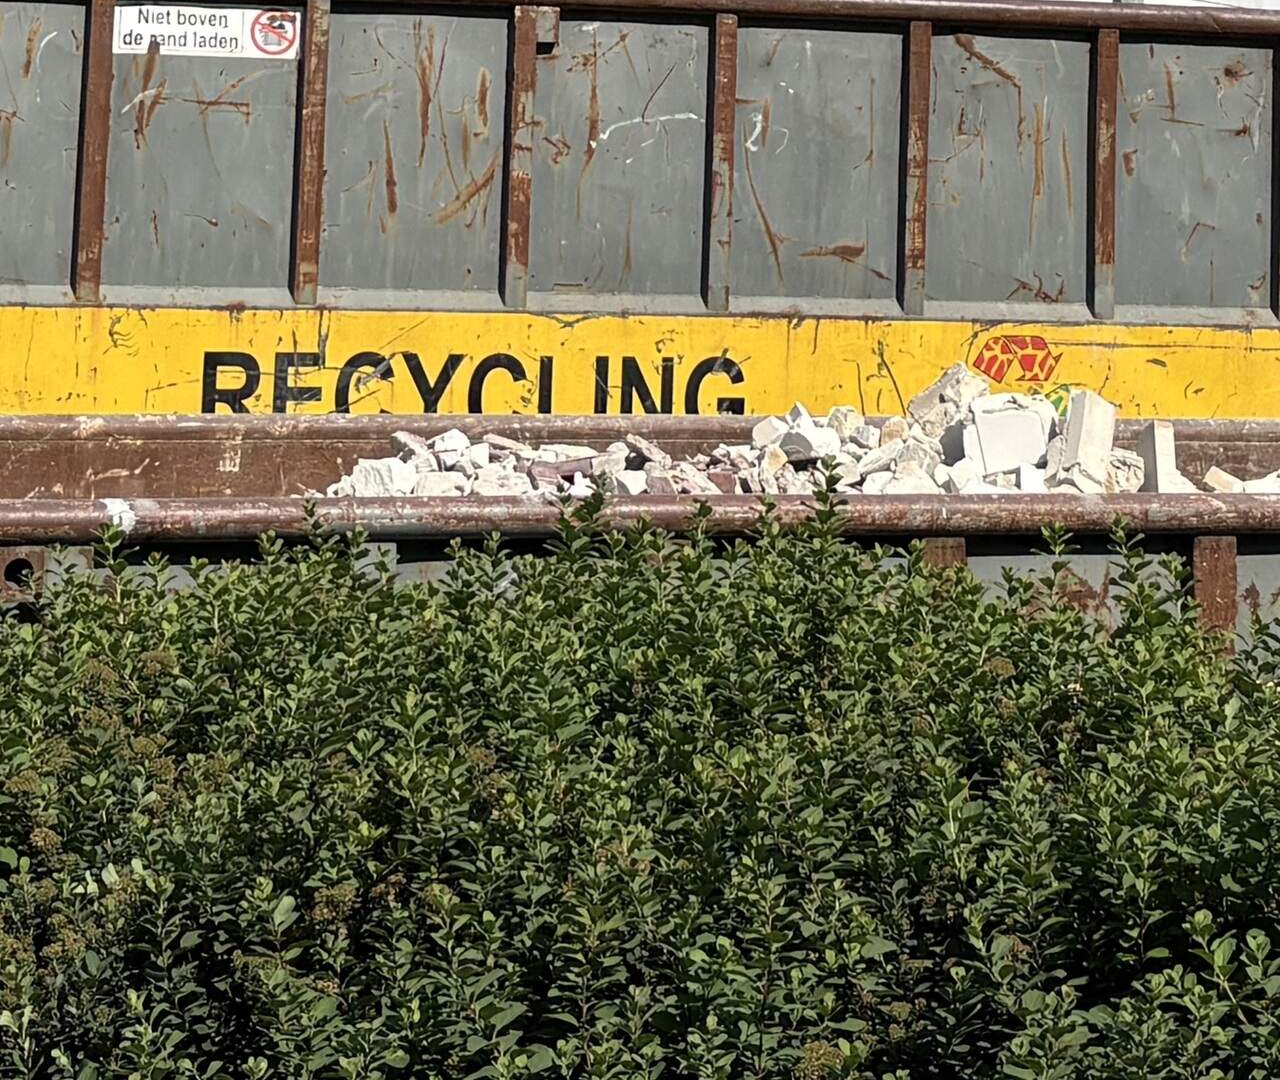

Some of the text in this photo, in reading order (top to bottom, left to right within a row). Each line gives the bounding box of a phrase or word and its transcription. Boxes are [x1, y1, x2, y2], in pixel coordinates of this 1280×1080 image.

[137, 8, 229, 28] Niet boven
[123, 29, 143, 46] de
[193, 32, 239, 50] laden
